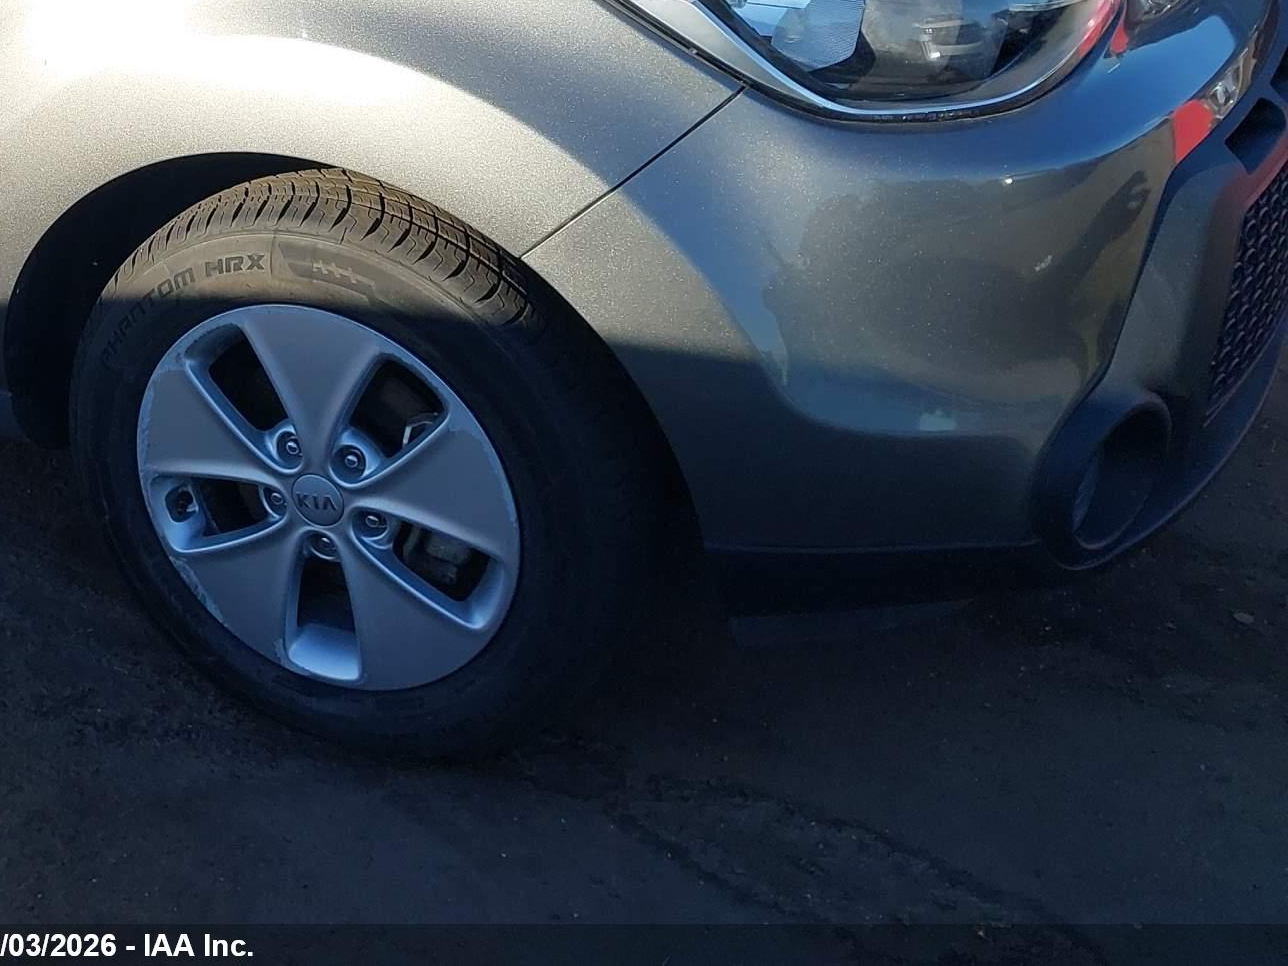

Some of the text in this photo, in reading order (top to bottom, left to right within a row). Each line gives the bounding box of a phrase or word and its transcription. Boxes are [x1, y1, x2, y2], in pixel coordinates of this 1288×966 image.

[100, 253, 265, 370] PHANTOM HRX
[296, 492, 337, 511] KIA
